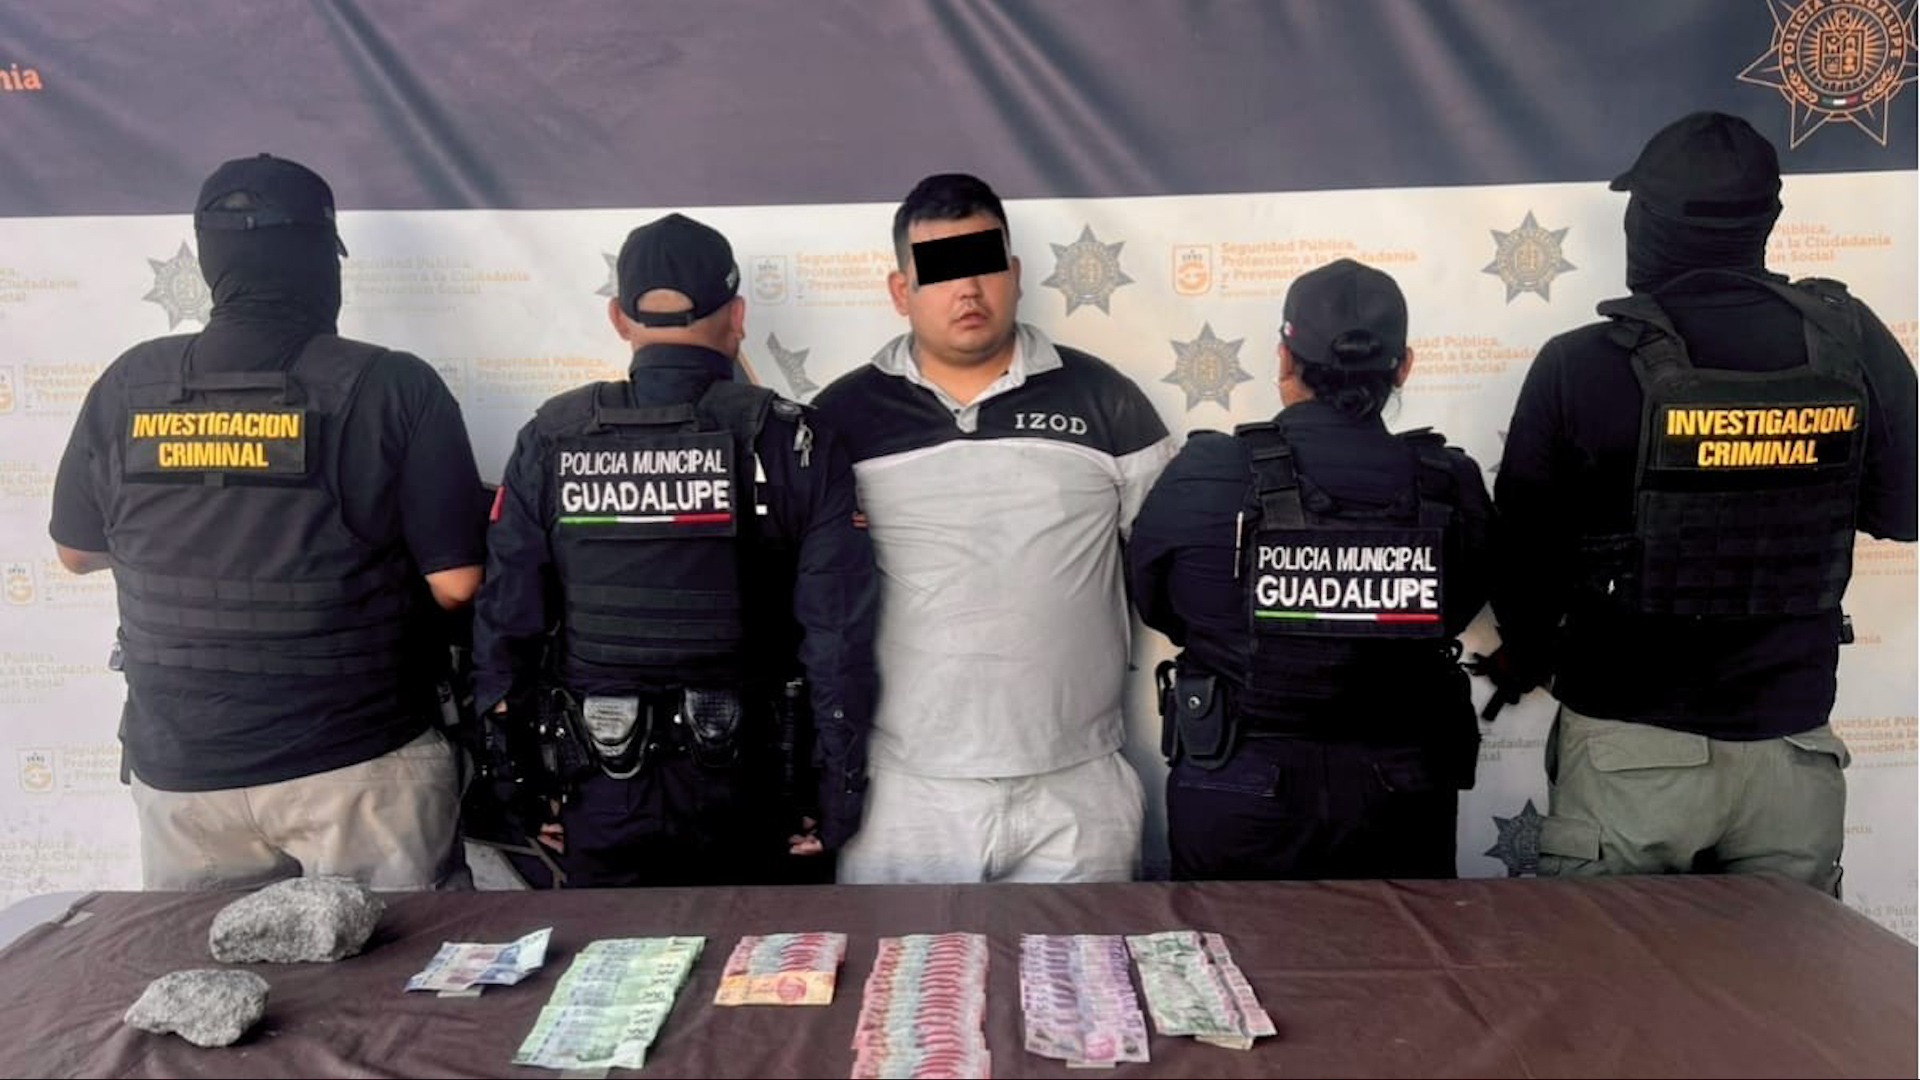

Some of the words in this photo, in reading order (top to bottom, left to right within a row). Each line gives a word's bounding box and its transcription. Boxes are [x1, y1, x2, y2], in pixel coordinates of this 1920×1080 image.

[132, 411, 299, 438] INVESTIGACION
[1015, 412, 1088, 436] IZOD
[1666, 406, 1856, 436] INVESTIGACION
[158, 442, 269, 468] CRIMINAL
[558, 450, 628, 477] POLICIA
[632, 448, 727, 474] MUNICIPAL
[1697, 439, 1819, 467] CRIMINAL
[561, 480, 731, 513] GUADALUPE
[1258, 546, 1332, 571] POLICIA
[1337, 546, 1437, 572] MUNICIPAL
[1256, 575, 1438, 609] GUADALUPE
